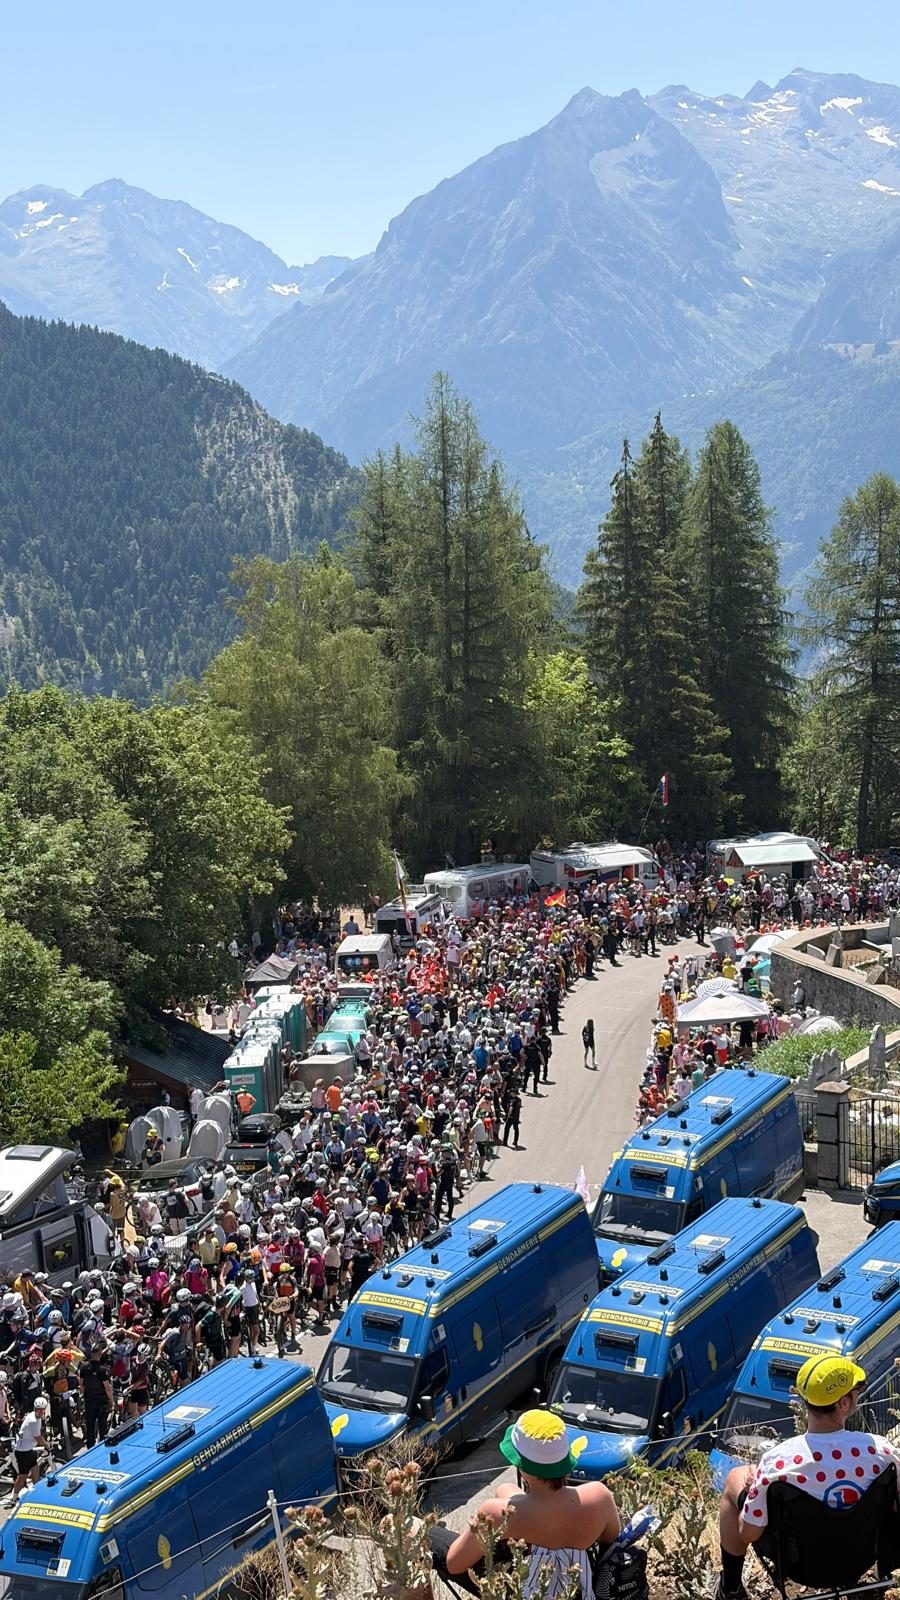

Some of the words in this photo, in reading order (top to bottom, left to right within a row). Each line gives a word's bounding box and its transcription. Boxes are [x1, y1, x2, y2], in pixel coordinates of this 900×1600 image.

[497, 1234, 539, 1270] GENDARMERIE
[728, 1250, 766, 1286] GENDARMERIE
[369, 1295, 415, 1308] GENDARMERIE
[601, 1312, 649, 1327] GENDARMERIE
[193, 1421, 251, 1466] GENDARMERIE
[29, 1507, 80, 1521] GENDARMERIE
